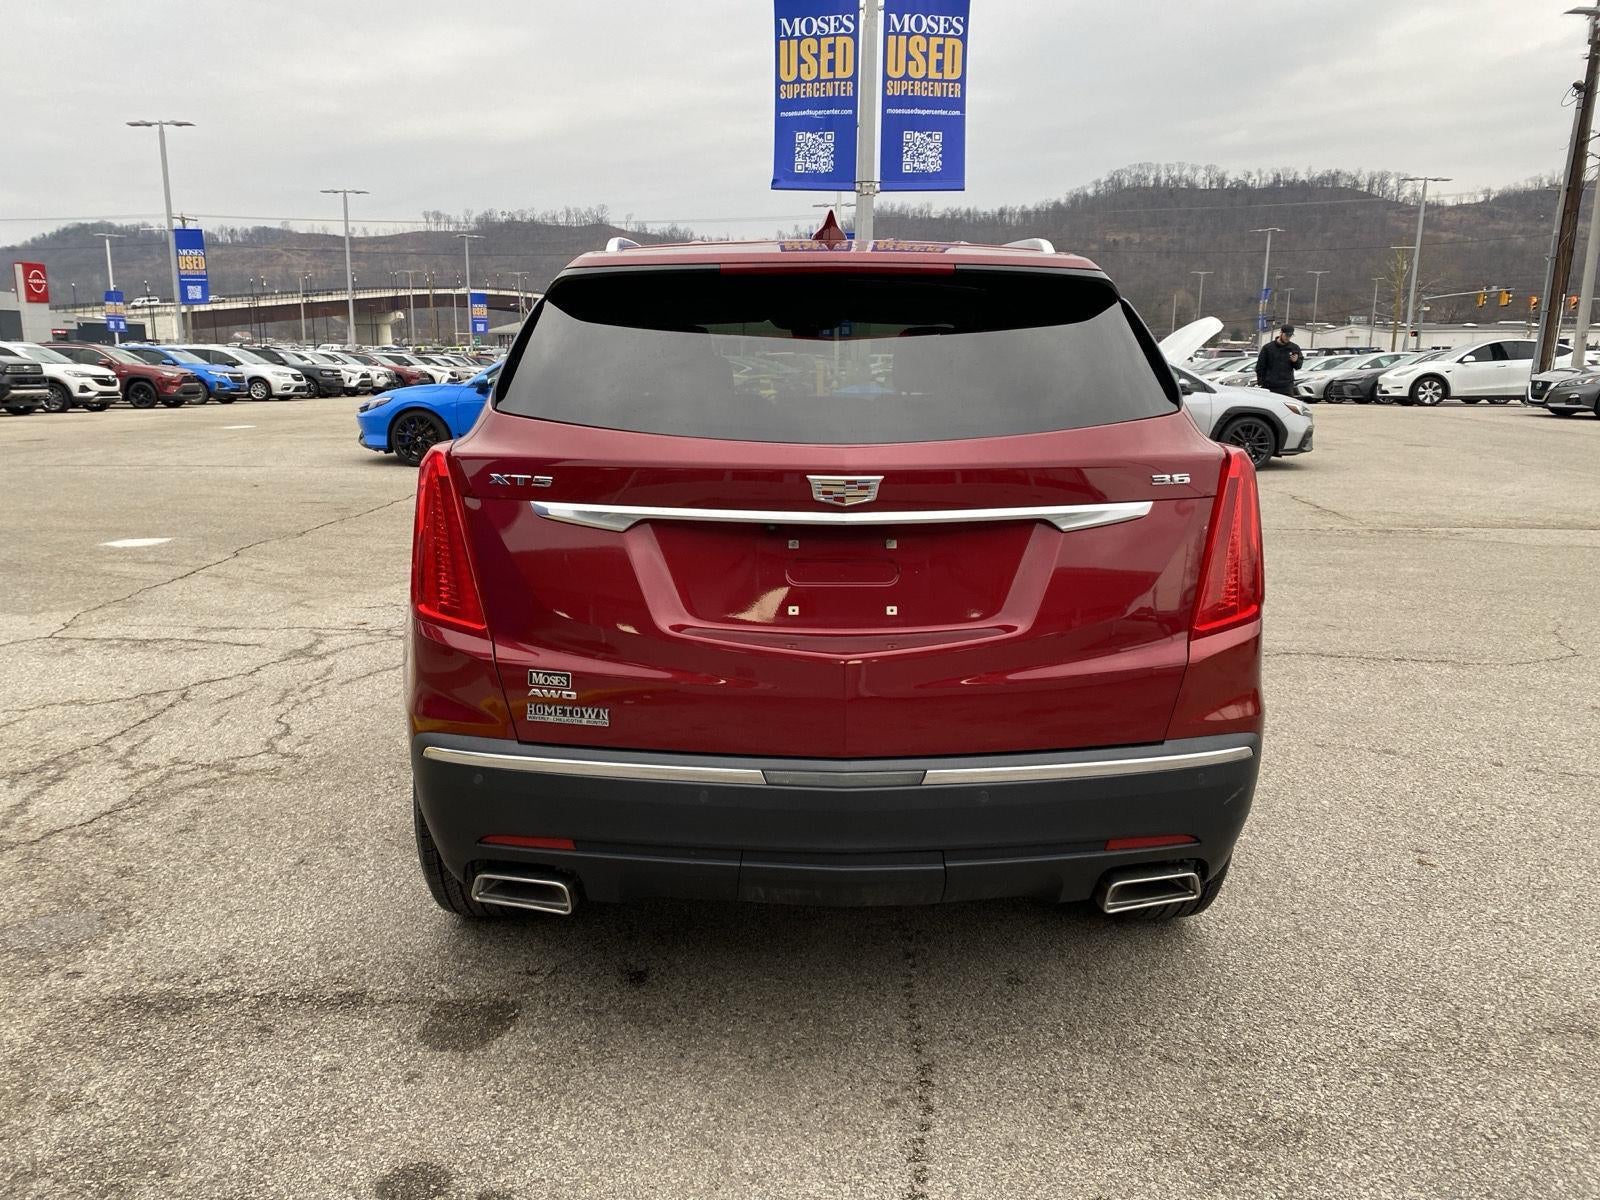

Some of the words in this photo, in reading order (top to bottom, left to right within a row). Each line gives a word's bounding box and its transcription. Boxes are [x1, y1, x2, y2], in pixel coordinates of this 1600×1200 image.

[780, 14, 855, 37] MOSES
[888, 13, 964, 36] MOSES
[779, 36, 855, 82] USED
[886, 35, 964, 80] USED
[780, 81, 853, 99] SUPERCENTER
[886, 80, 961, 98] SUPERCENTER
[780, 108, 852, 117] mosesusedsupercenter.com
[886, 108, 961, 116] mosesusedsupercenter.com
[178, 248, 204, 256] MOSES
[178, 255, 206, 270] USED
[489, 473, 554, 488] XT5
[531, 672, 568, 687] MOSES
[528, 688, 577, 700] AWD
[527, 703, 609, 720] HOMETOWN
